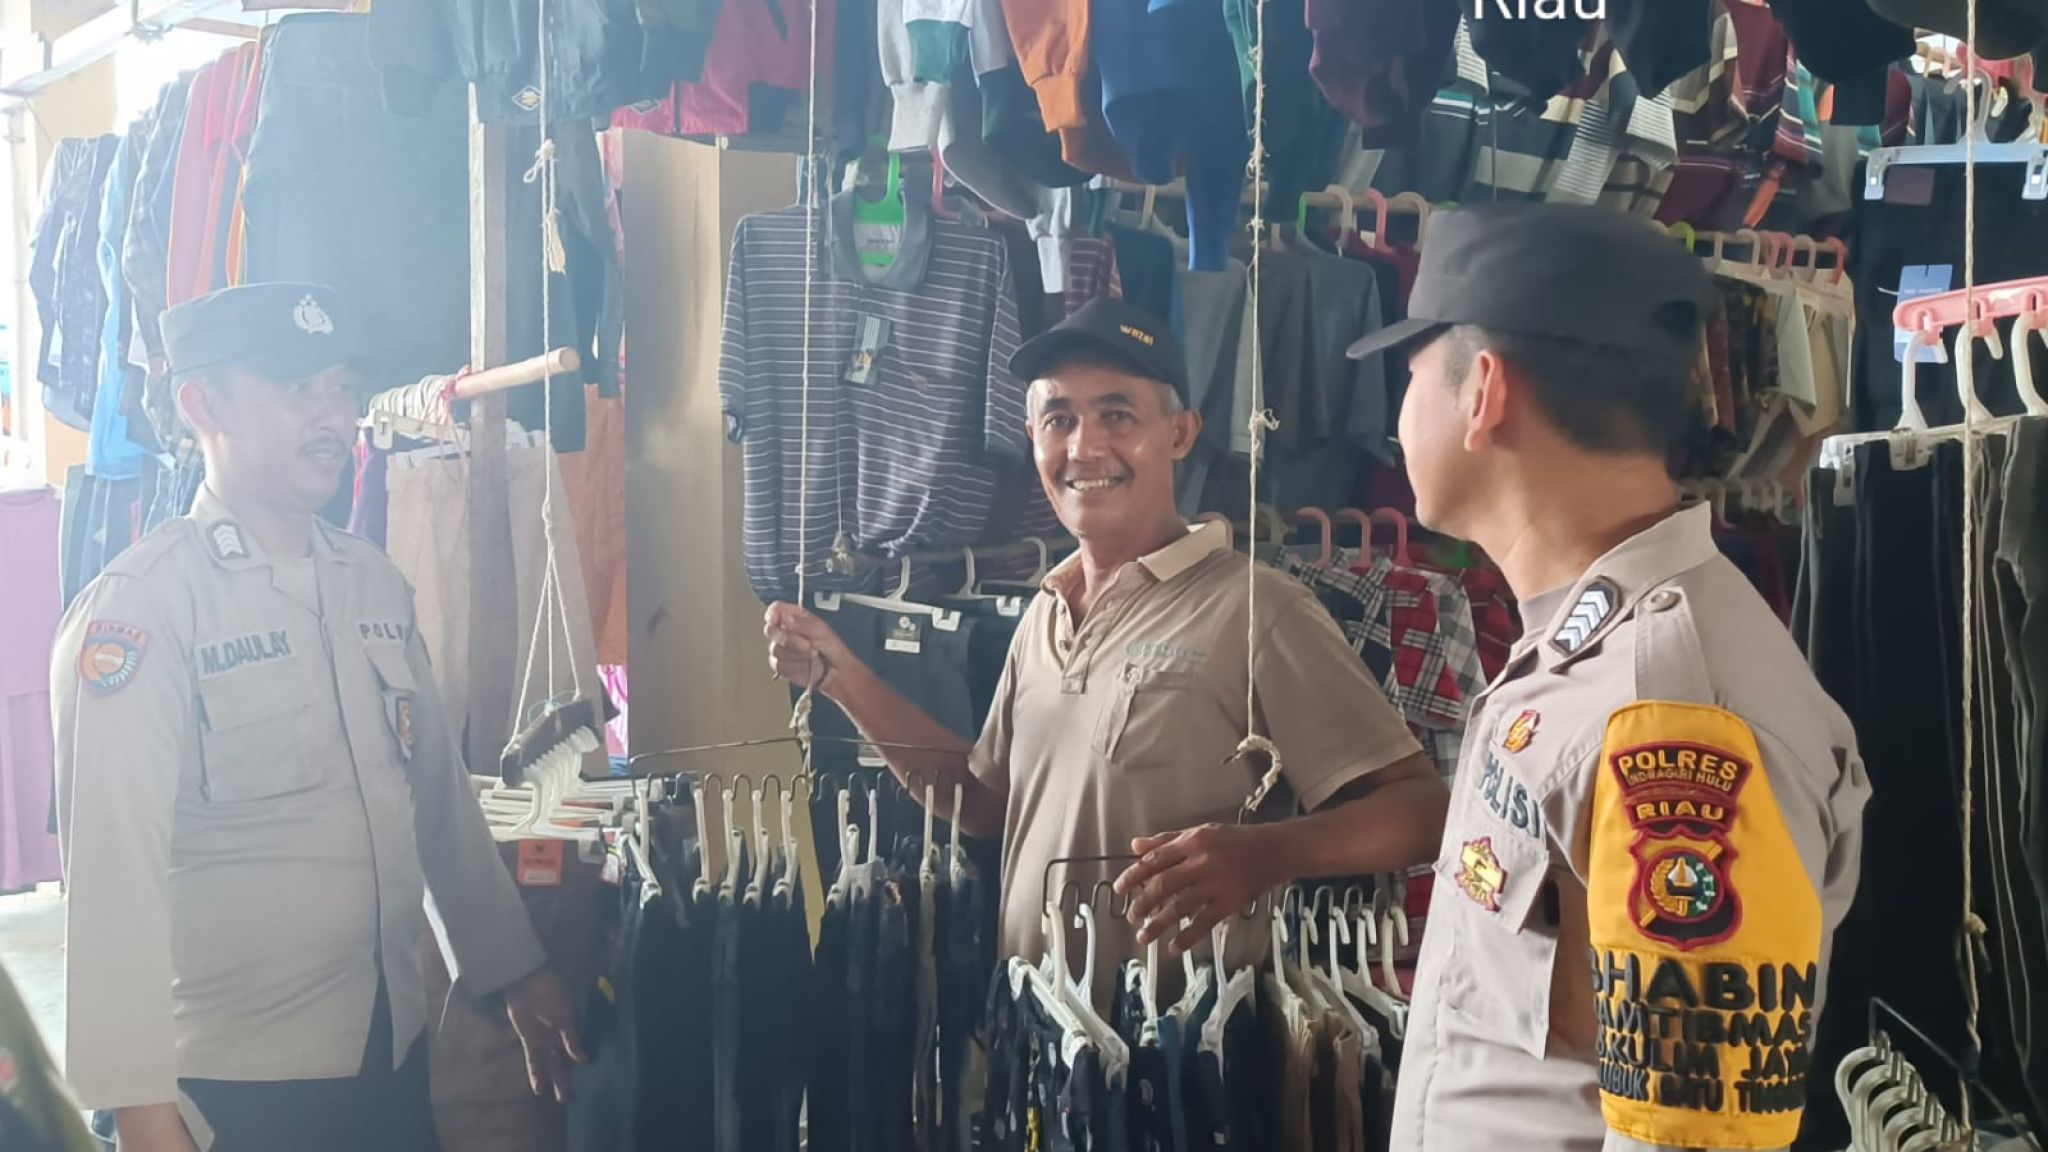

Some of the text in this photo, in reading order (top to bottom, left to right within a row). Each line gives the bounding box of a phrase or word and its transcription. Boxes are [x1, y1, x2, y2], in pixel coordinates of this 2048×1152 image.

[200, 630, 292, 675] M.DAULAY
[1617, 749, 1739, 781] POLRES
[1625, 768, 1733, 792] INDRAGIRI HULU
[1636, 800, 1724, 820] RIAU
[1594, 996, 1813, 1048] AMTIBMAS
